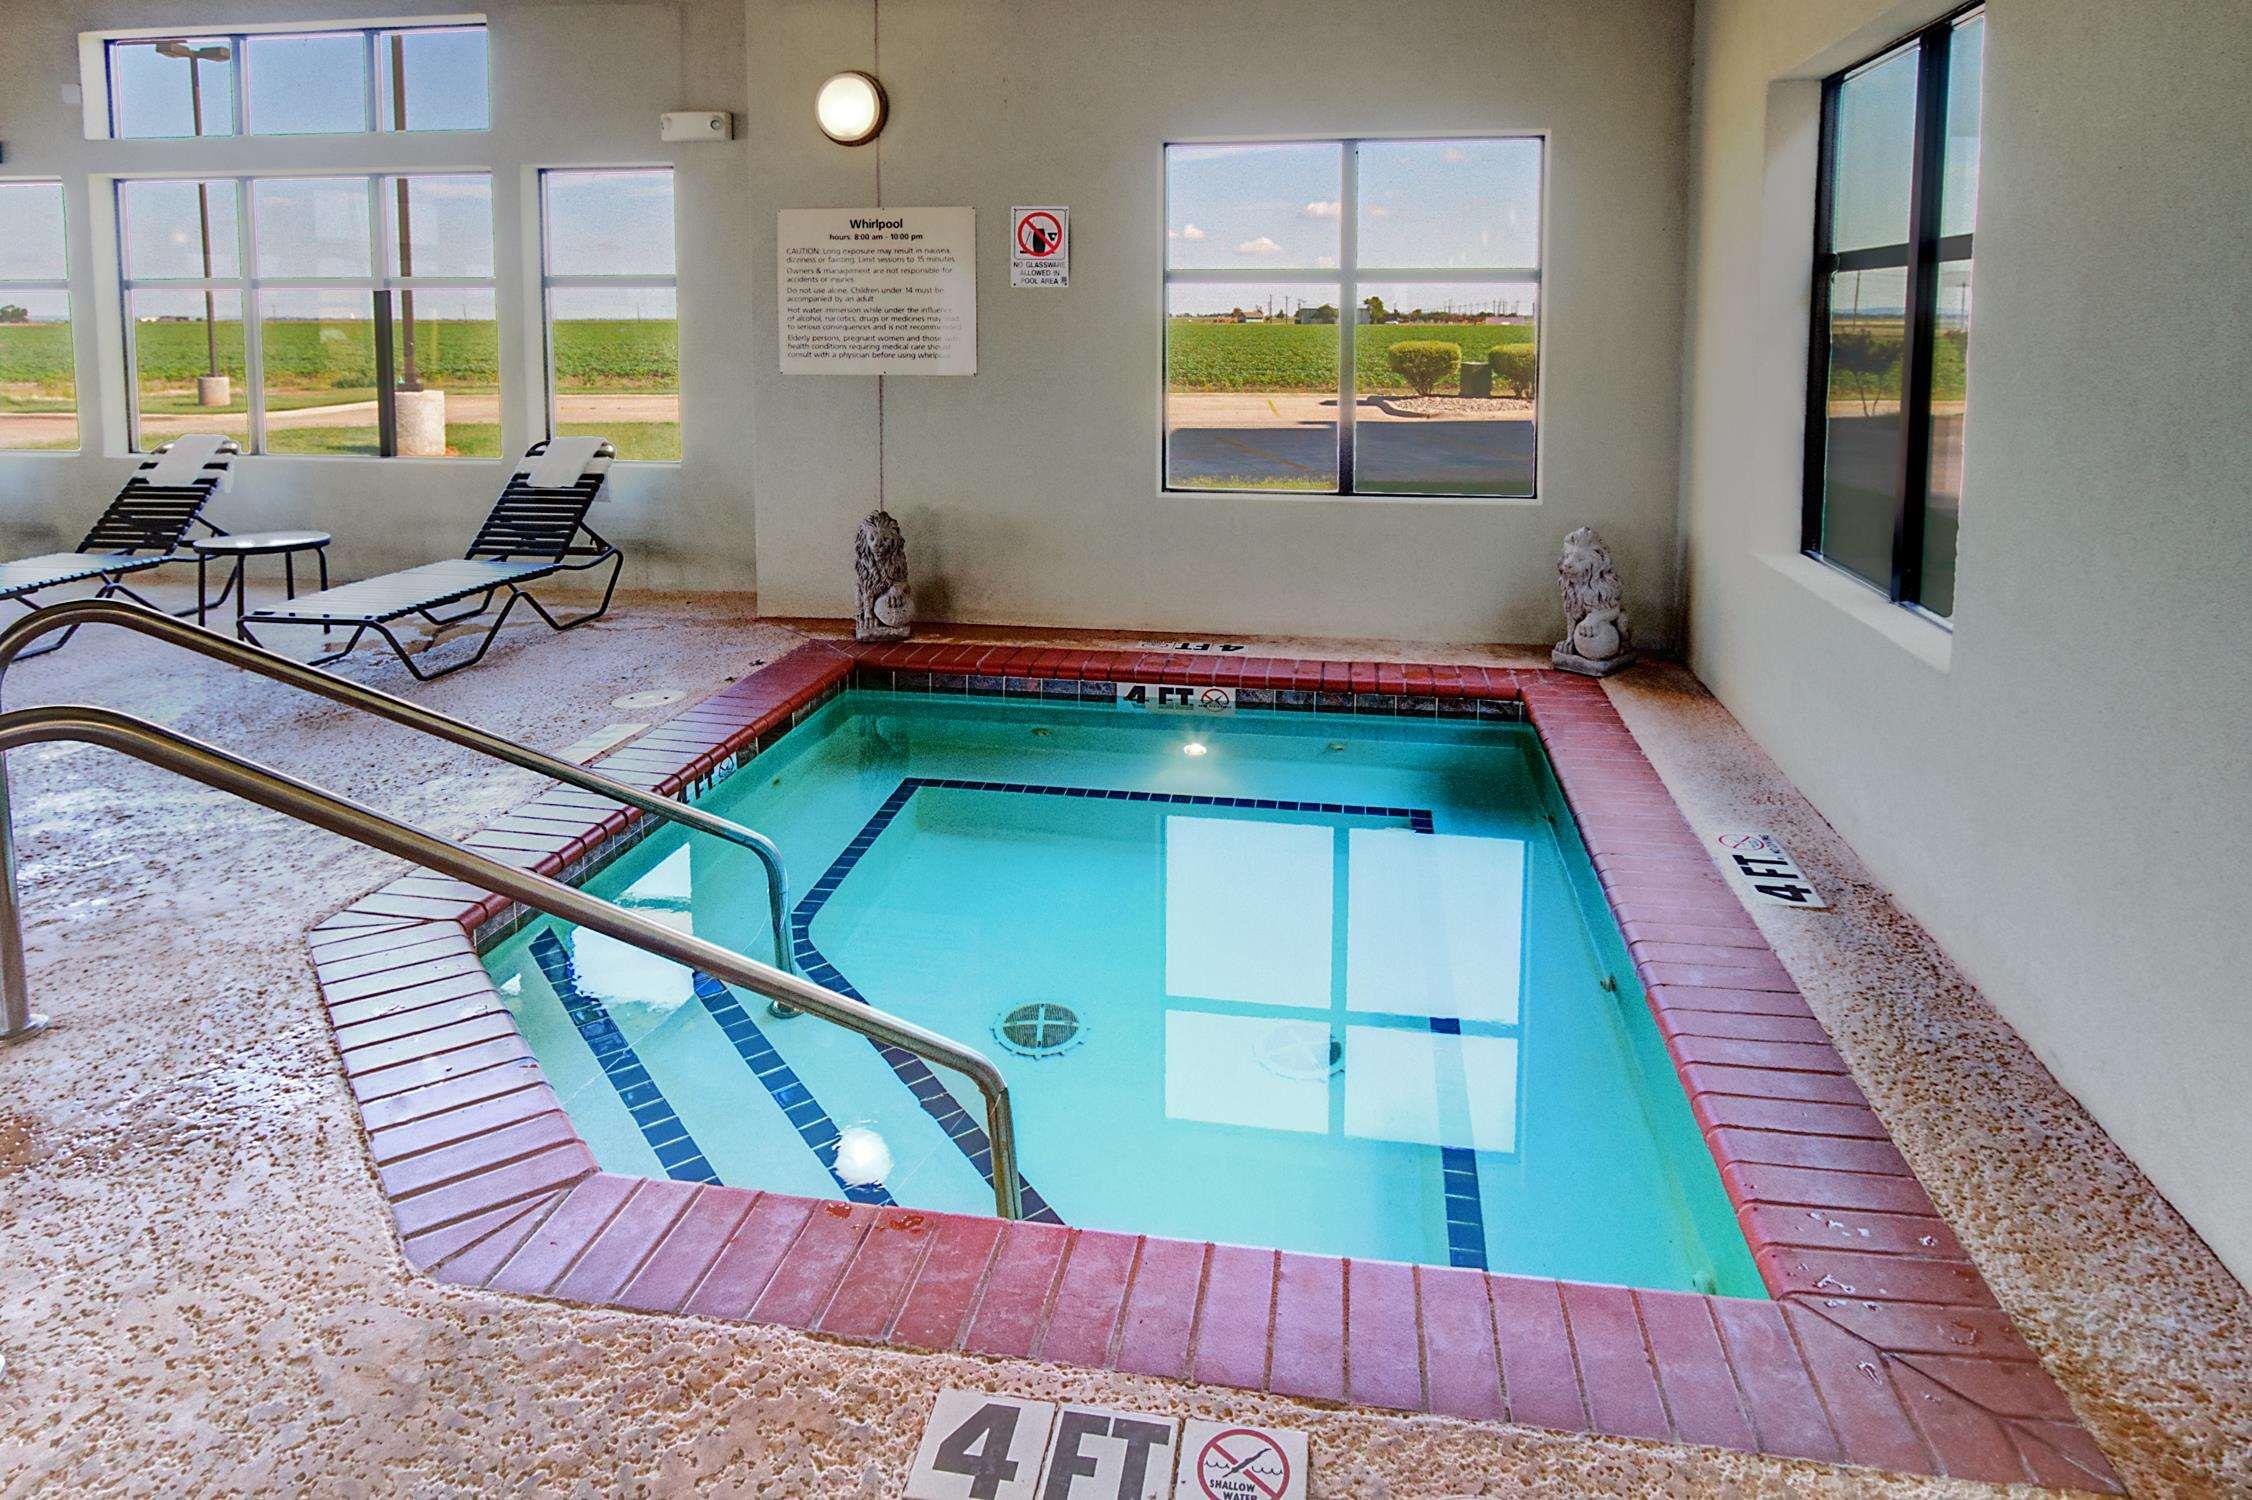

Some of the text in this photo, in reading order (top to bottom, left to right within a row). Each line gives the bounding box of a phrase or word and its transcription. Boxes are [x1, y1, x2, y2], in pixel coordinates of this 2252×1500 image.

[849, 218, 903, 230] Whirlpool
[822, 247, 841, 255] Long
[842, 247, 874, 255] exposure
[877, 247, 892, 255] may
[1122, 685, 1194, 706] 4 FT
[1731, 854, 1800, 879] FT
[1753, 884, 1813, 903] 4
[931, 1403, 1172, 1500] 4 FT
[1210, 1479, 1256, 1493] SHALLOW
[1222, 1491, 1258, 1500] WATER
